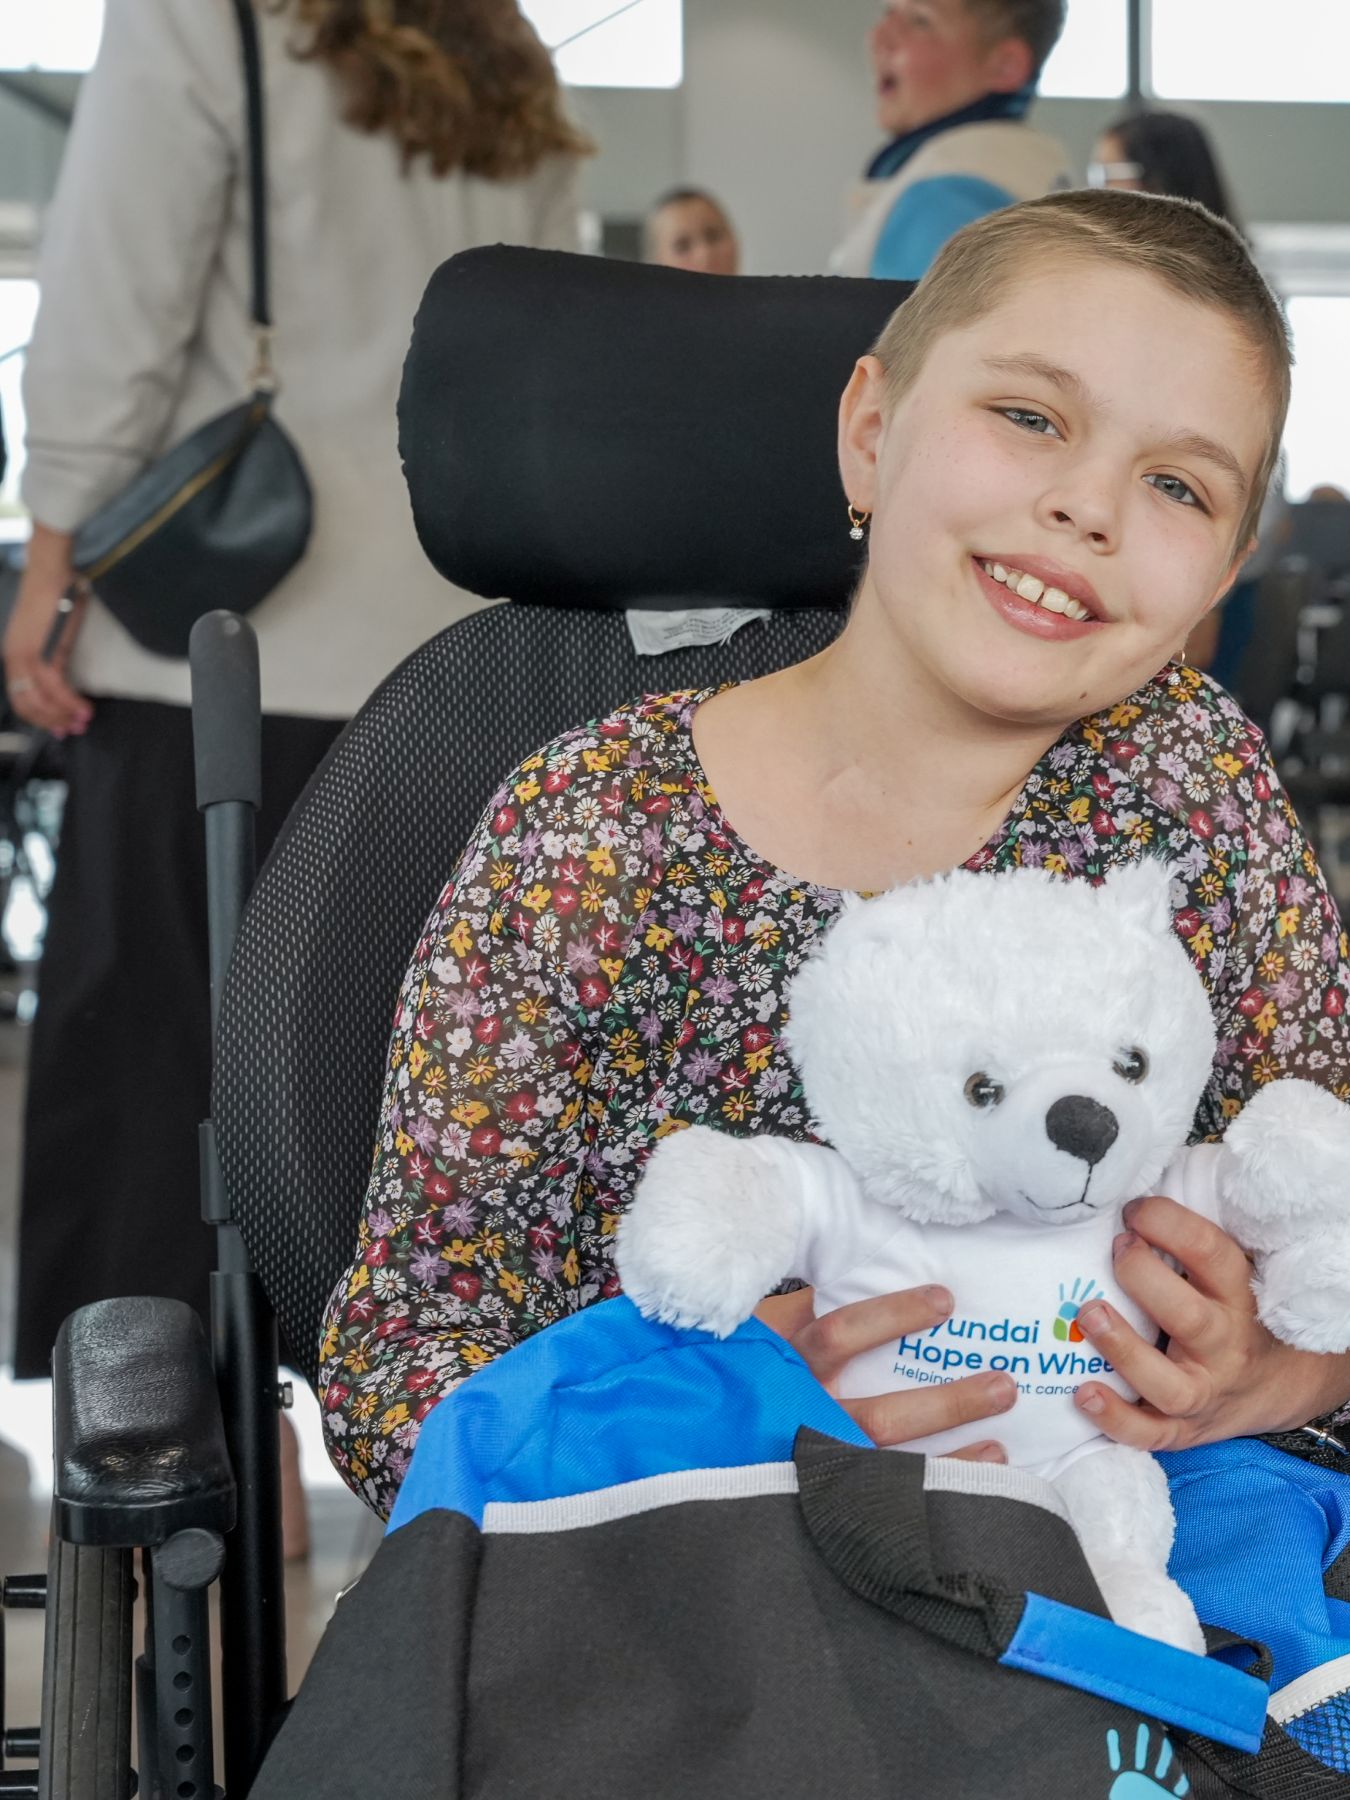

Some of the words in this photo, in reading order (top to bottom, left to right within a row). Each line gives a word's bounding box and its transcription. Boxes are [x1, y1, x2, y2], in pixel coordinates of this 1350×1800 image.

[898, 1336, 983, 1370] Hope
[989, 1355, 1030, 1374] on
[1038, 1352, 1115, 1375] Whee
[1036, 1384, 1080, 1395] cance
